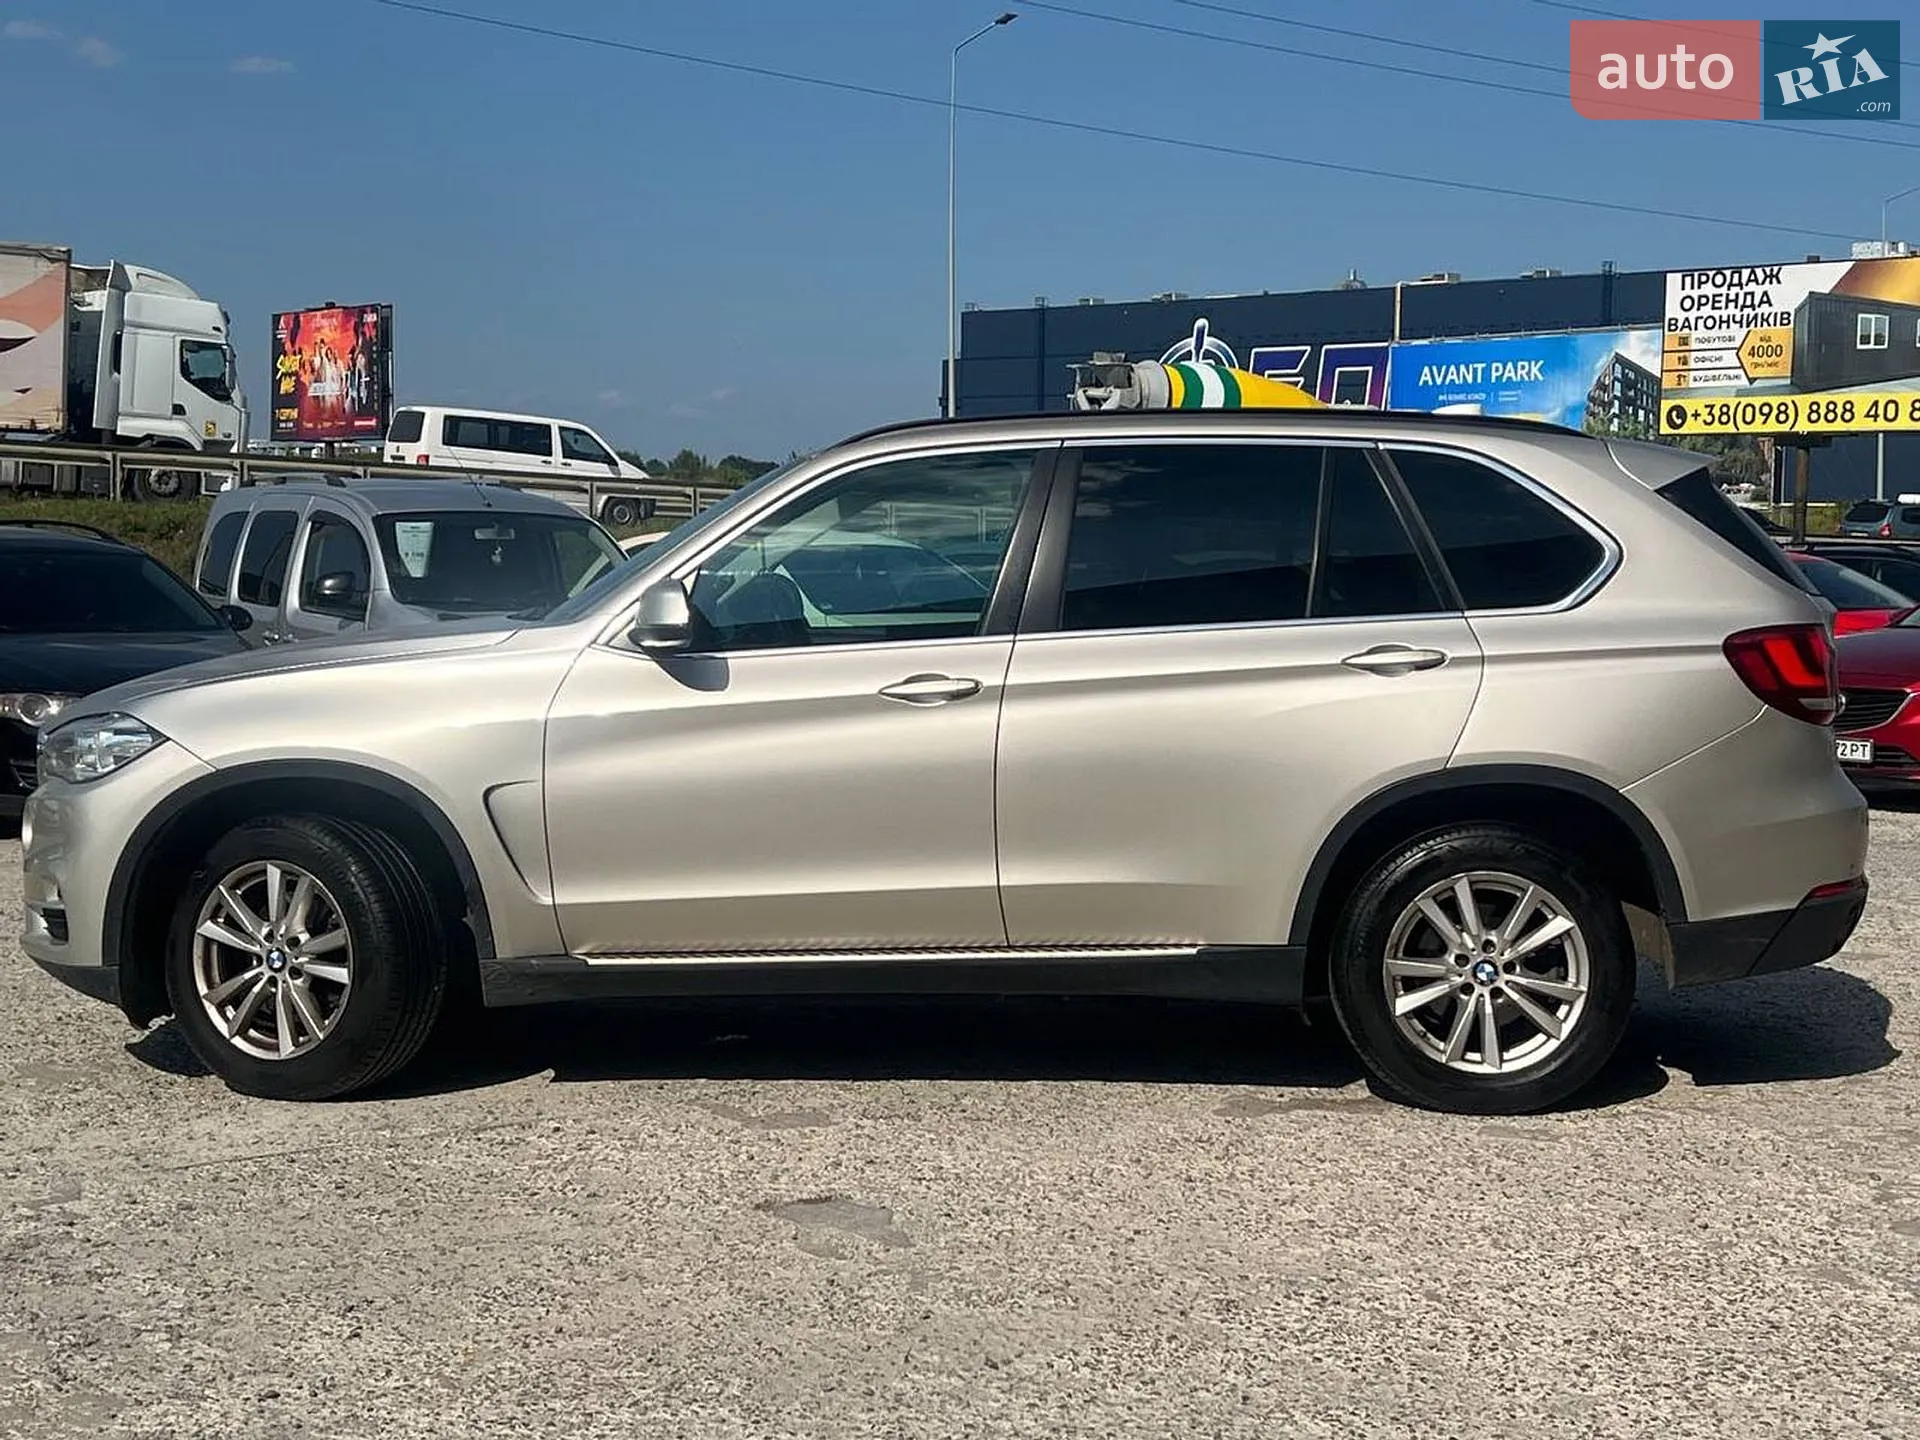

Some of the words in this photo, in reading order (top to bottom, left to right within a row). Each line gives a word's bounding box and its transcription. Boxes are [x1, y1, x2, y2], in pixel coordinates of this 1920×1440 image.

[1681, 267, 1782, 291] ПРОДАЖ
[1680, 290, 1773, 313] ОРЕНДА
[1667, 311, 1792, 333] ВАГОНЧИКІВ
[1747, 344, 1784, 358] 4000
[1418, 362, 1487, 387] AVANT
[1490, 359, 1545, 384] PARK
[1691, 400, 1799, 431] +38(098)
[1807, 400, 1855, 424] 888
[1864, 399, 1900, 423] 40
